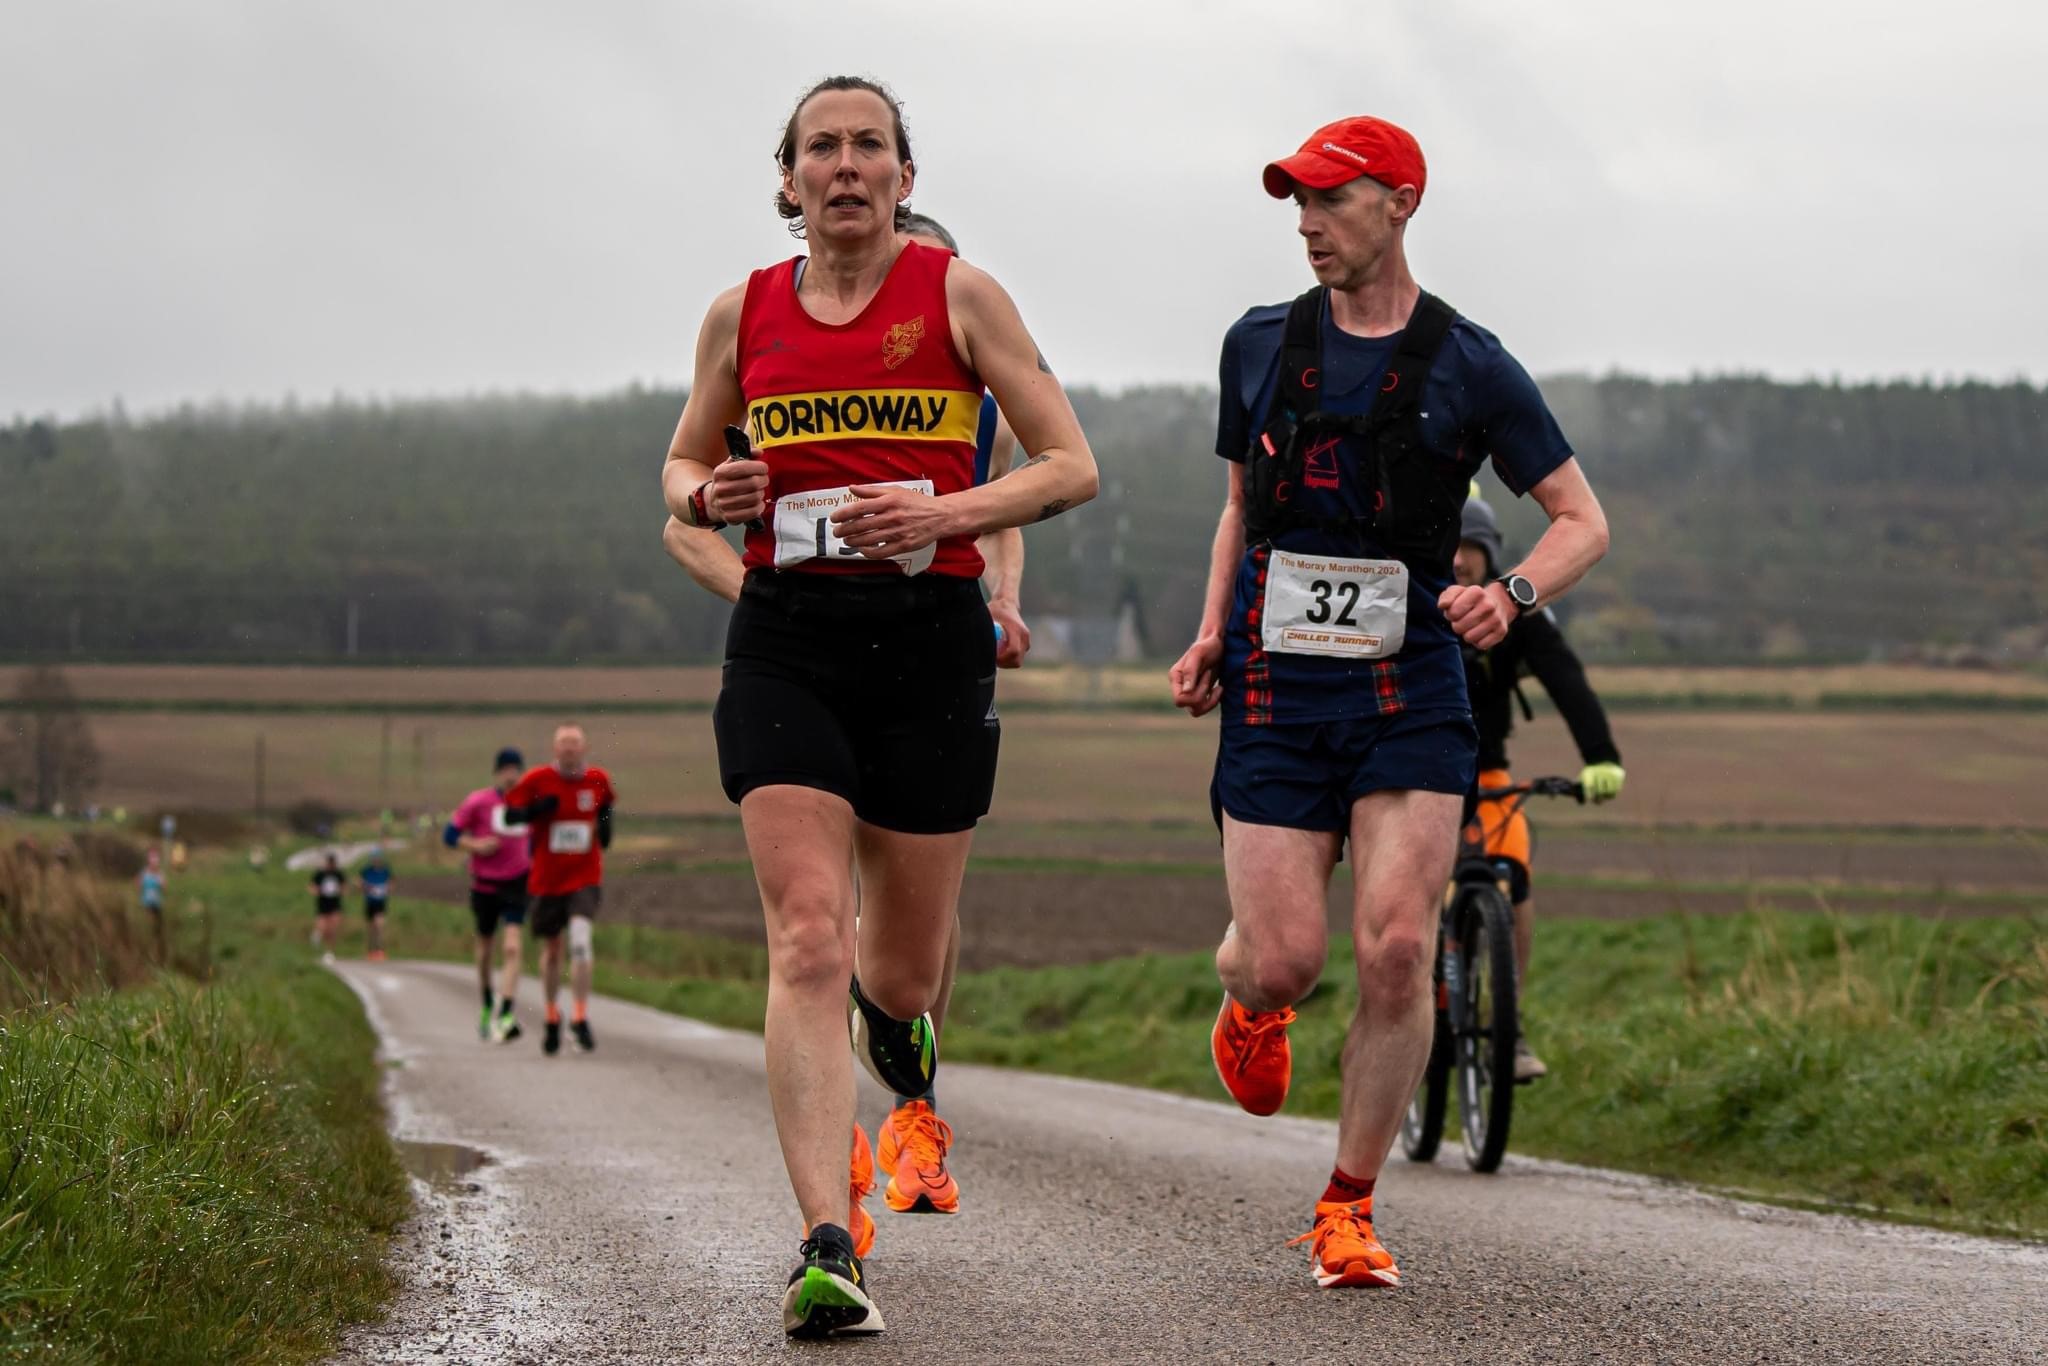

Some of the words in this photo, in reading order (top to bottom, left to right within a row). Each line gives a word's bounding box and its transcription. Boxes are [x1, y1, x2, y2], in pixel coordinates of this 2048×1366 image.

[785, 501, 805, 511] The
[807, 496, 840, 508] Moray
[1280, 556, 1295, 567] The
[1297, 559, 1326, 572] Moray
[1329, 562, 1375, 574] Marathon
[1376, 566, 1401, 576] 2024
[1305, 579, 1361, 627] 32
[1287, 631, 1330, 643] CHILLED
